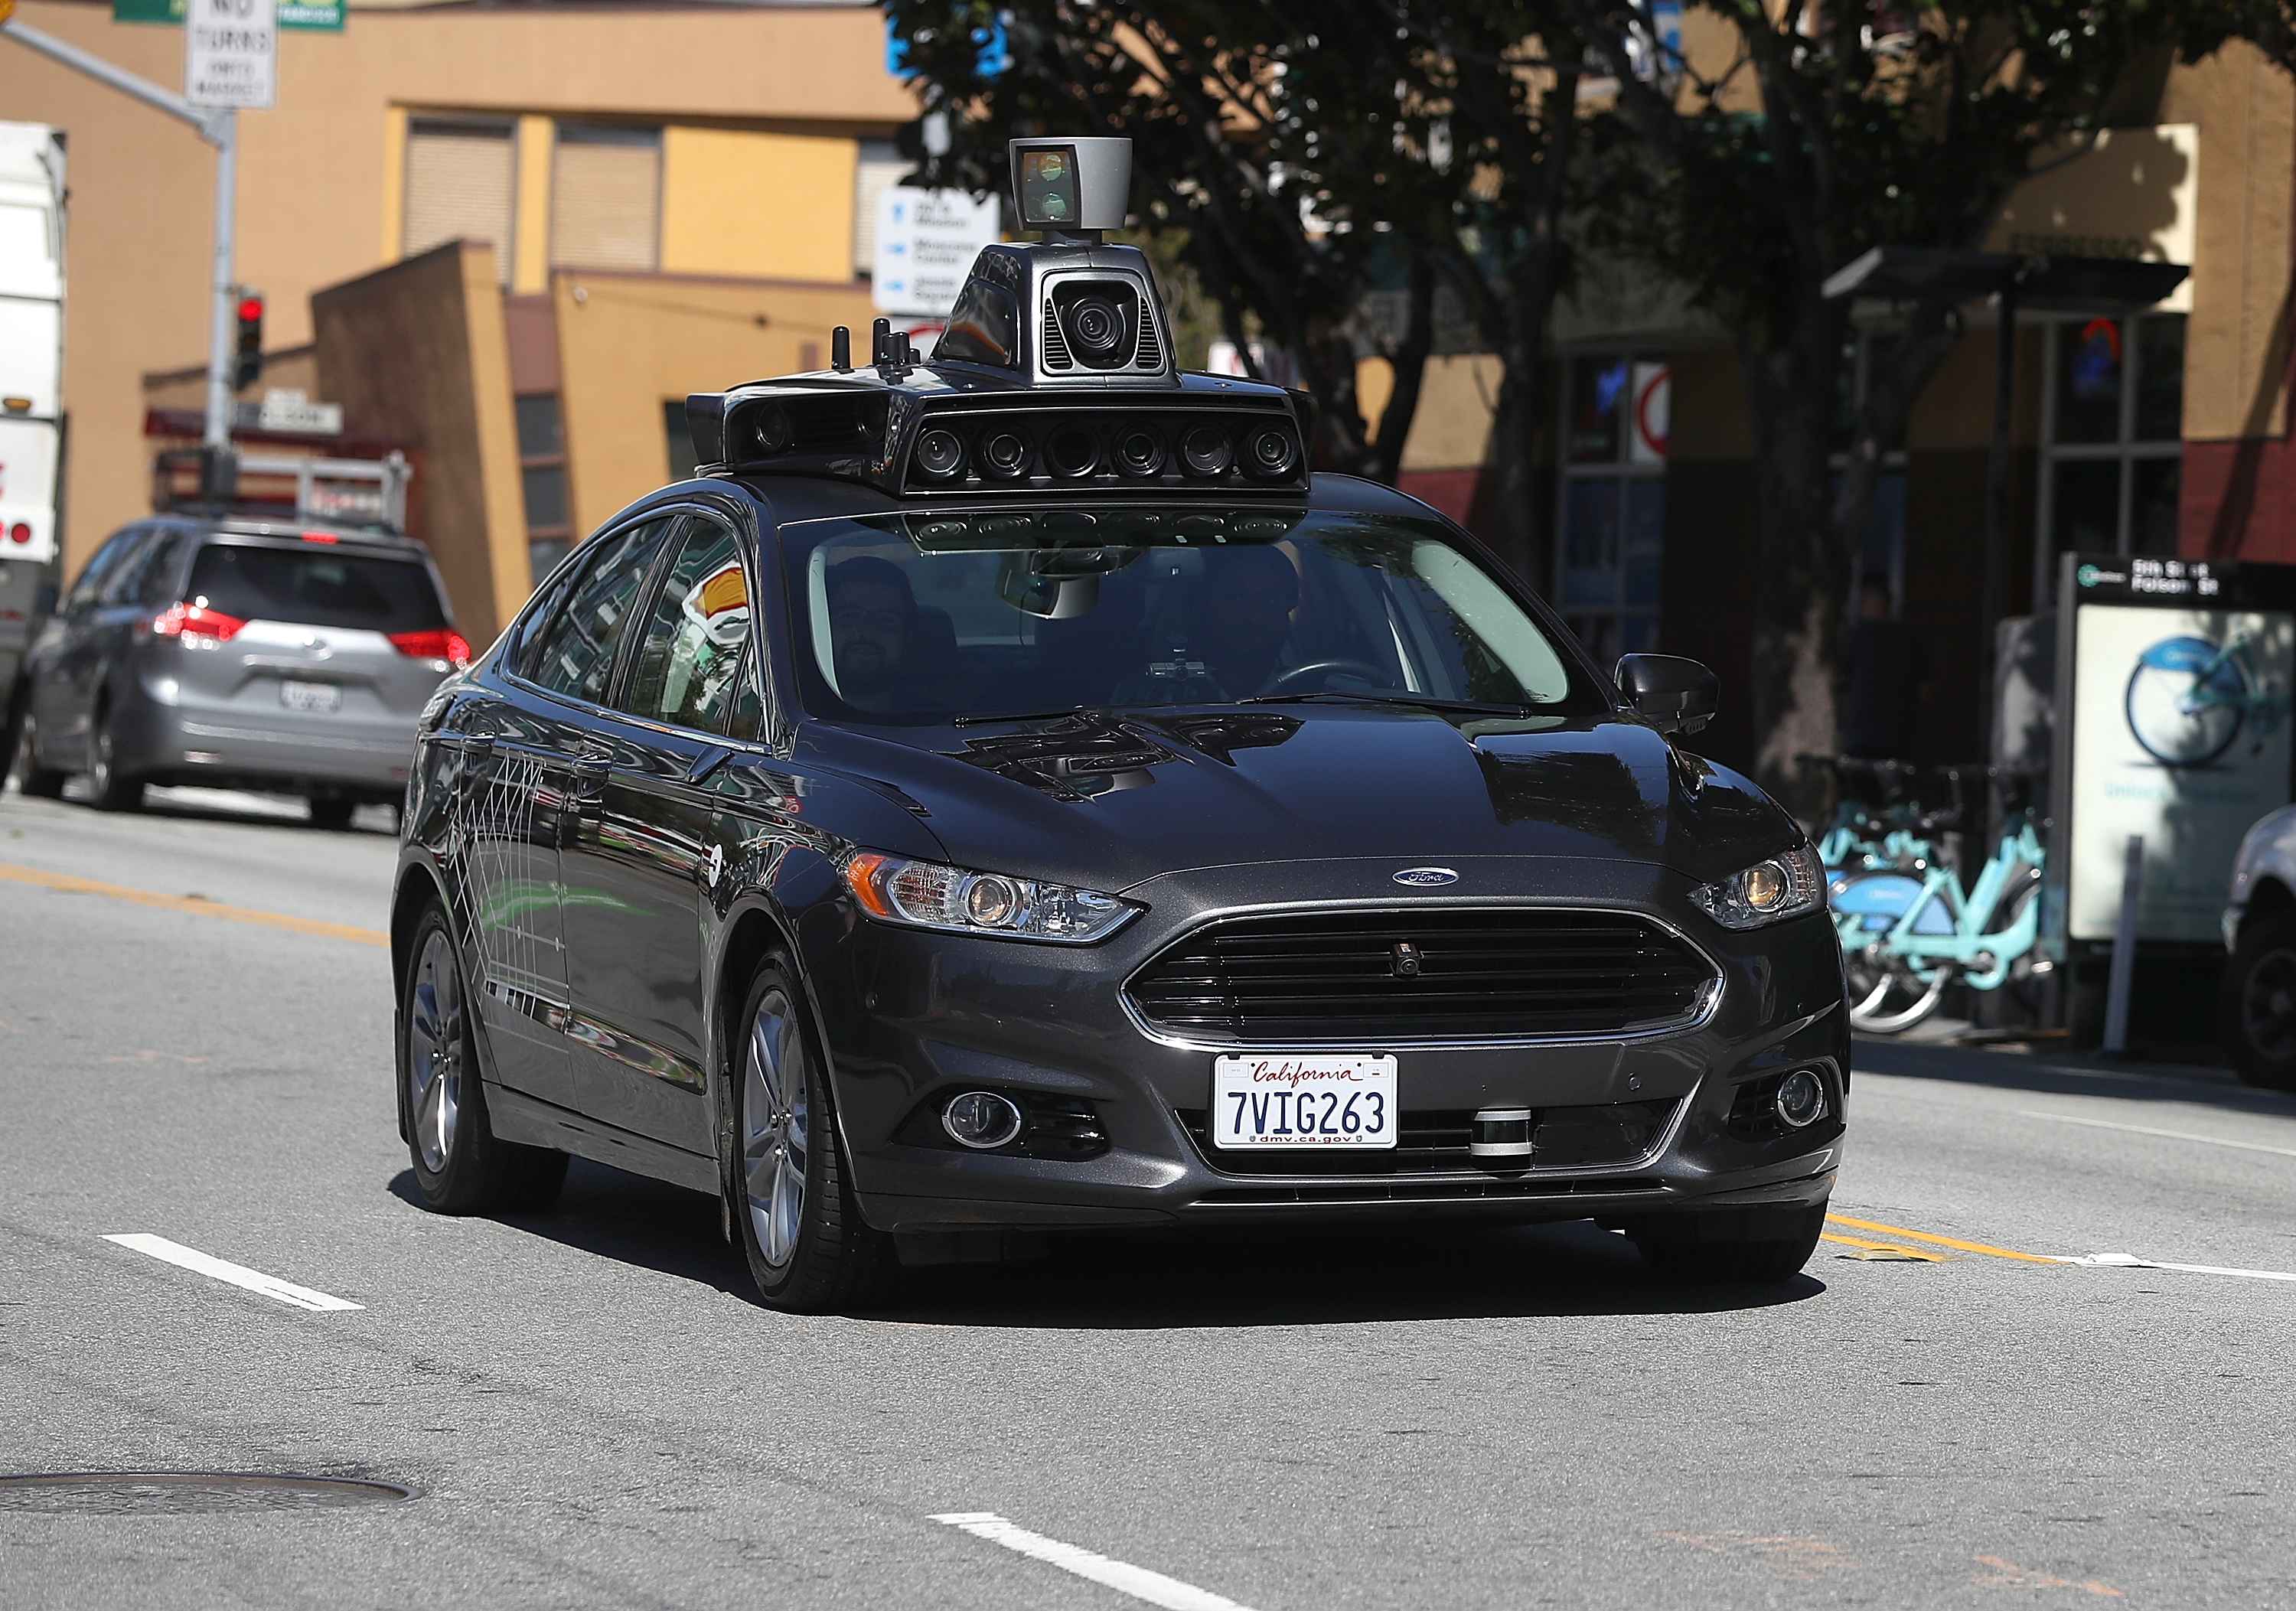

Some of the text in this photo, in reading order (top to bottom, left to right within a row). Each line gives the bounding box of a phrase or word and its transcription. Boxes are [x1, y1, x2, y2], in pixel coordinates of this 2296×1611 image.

[197, 28, 270, 52] TURNS
[1408, 872, 1444, 882] Ford
[1254, 1061, 1364, 1088] California
[1228, 1091, 1384, 1134] 7VIG263
